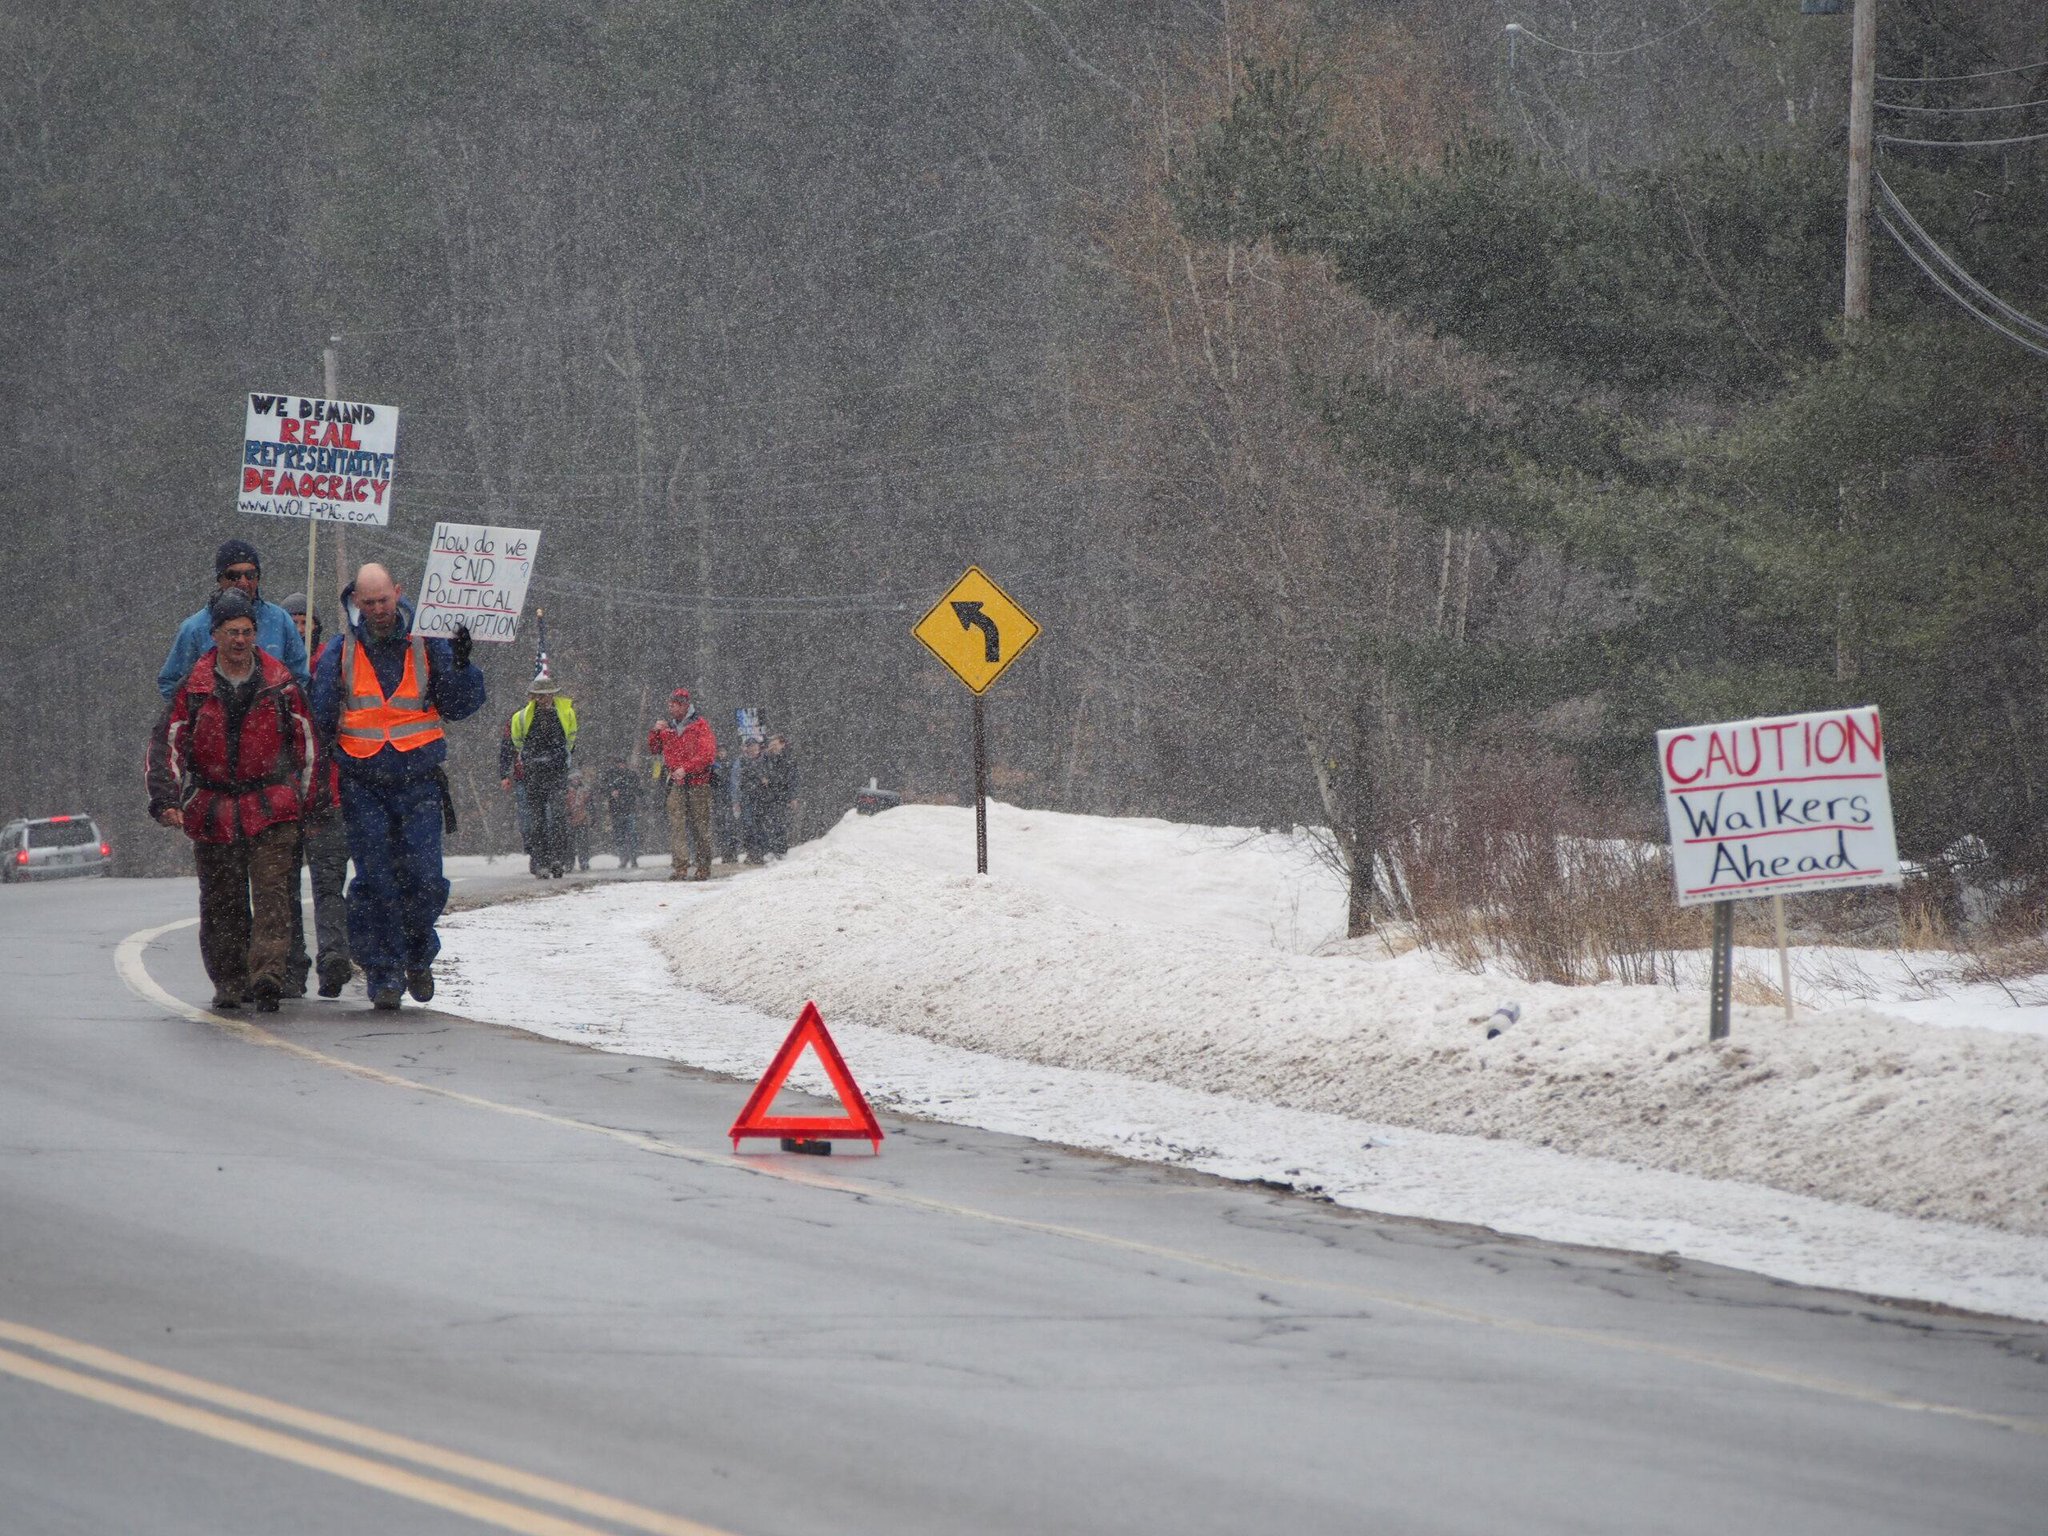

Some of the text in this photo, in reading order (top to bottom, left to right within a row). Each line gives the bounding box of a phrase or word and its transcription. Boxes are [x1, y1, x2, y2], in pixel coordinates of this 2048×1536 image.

[251, 394, 375, 425] WE DEMAND
[279, 417, 361, 450] REAL
[244, 439, 393, 479] REPRESENTATIVE
[242, 467, 390, 506] DEMOCRACY
[435, 525, 527, 557] How do we
[451, 555, 495, 584] END
[1666, 712, 1882, 784] CAUTION
[1679, 788, 1872, 837] Walkers
[1710, 829, 1859, 884] Ahead
